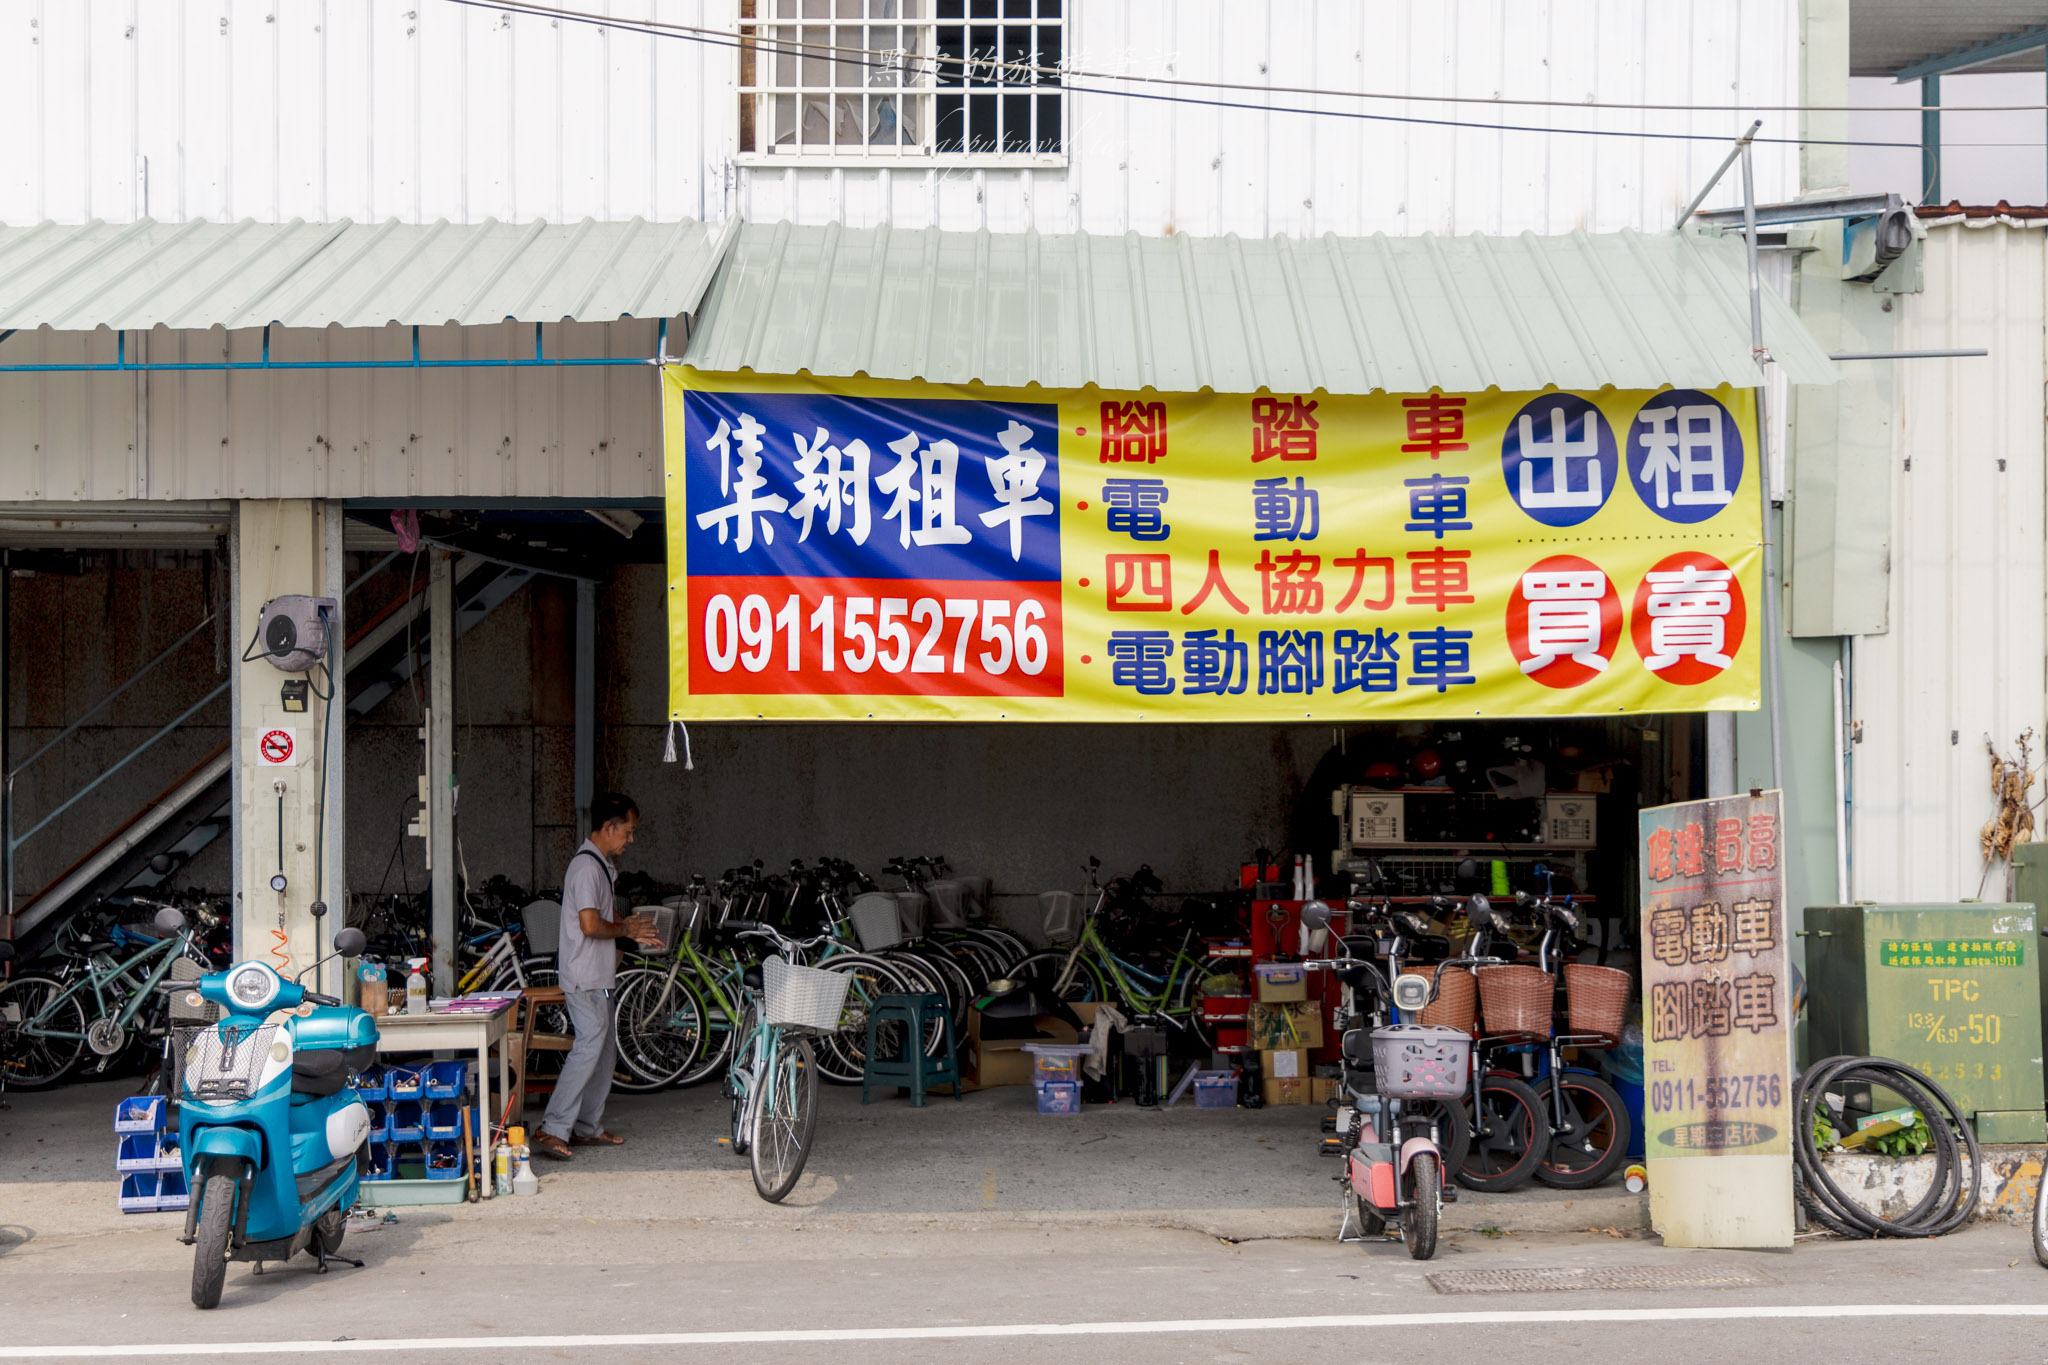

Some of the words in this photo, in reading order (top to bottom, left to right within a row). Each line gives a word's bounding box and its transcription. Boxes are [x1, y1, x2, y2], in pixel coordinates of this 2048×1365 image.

[696, 411, 1054, 562] 集翔租車
[1519, 405, 1733, 509] 出租
[1105, 546, 1475, 616] 四人協力車
[704, 593, 1048, 676] 0911552756
[1519, 565, 1733, 674] 買賣
[1107, 626, 1476, 696] 電動腳踏車
[1652, 897, 1776, 967] 電動車
[1652, 973, 1777, 1042] 腳踏車
[1928, 979, 1981, 1003] TPC
[1651, 1074, 1781, 1114] 0911-552756
[1652, 1060, 1676, 1073] TEL:
